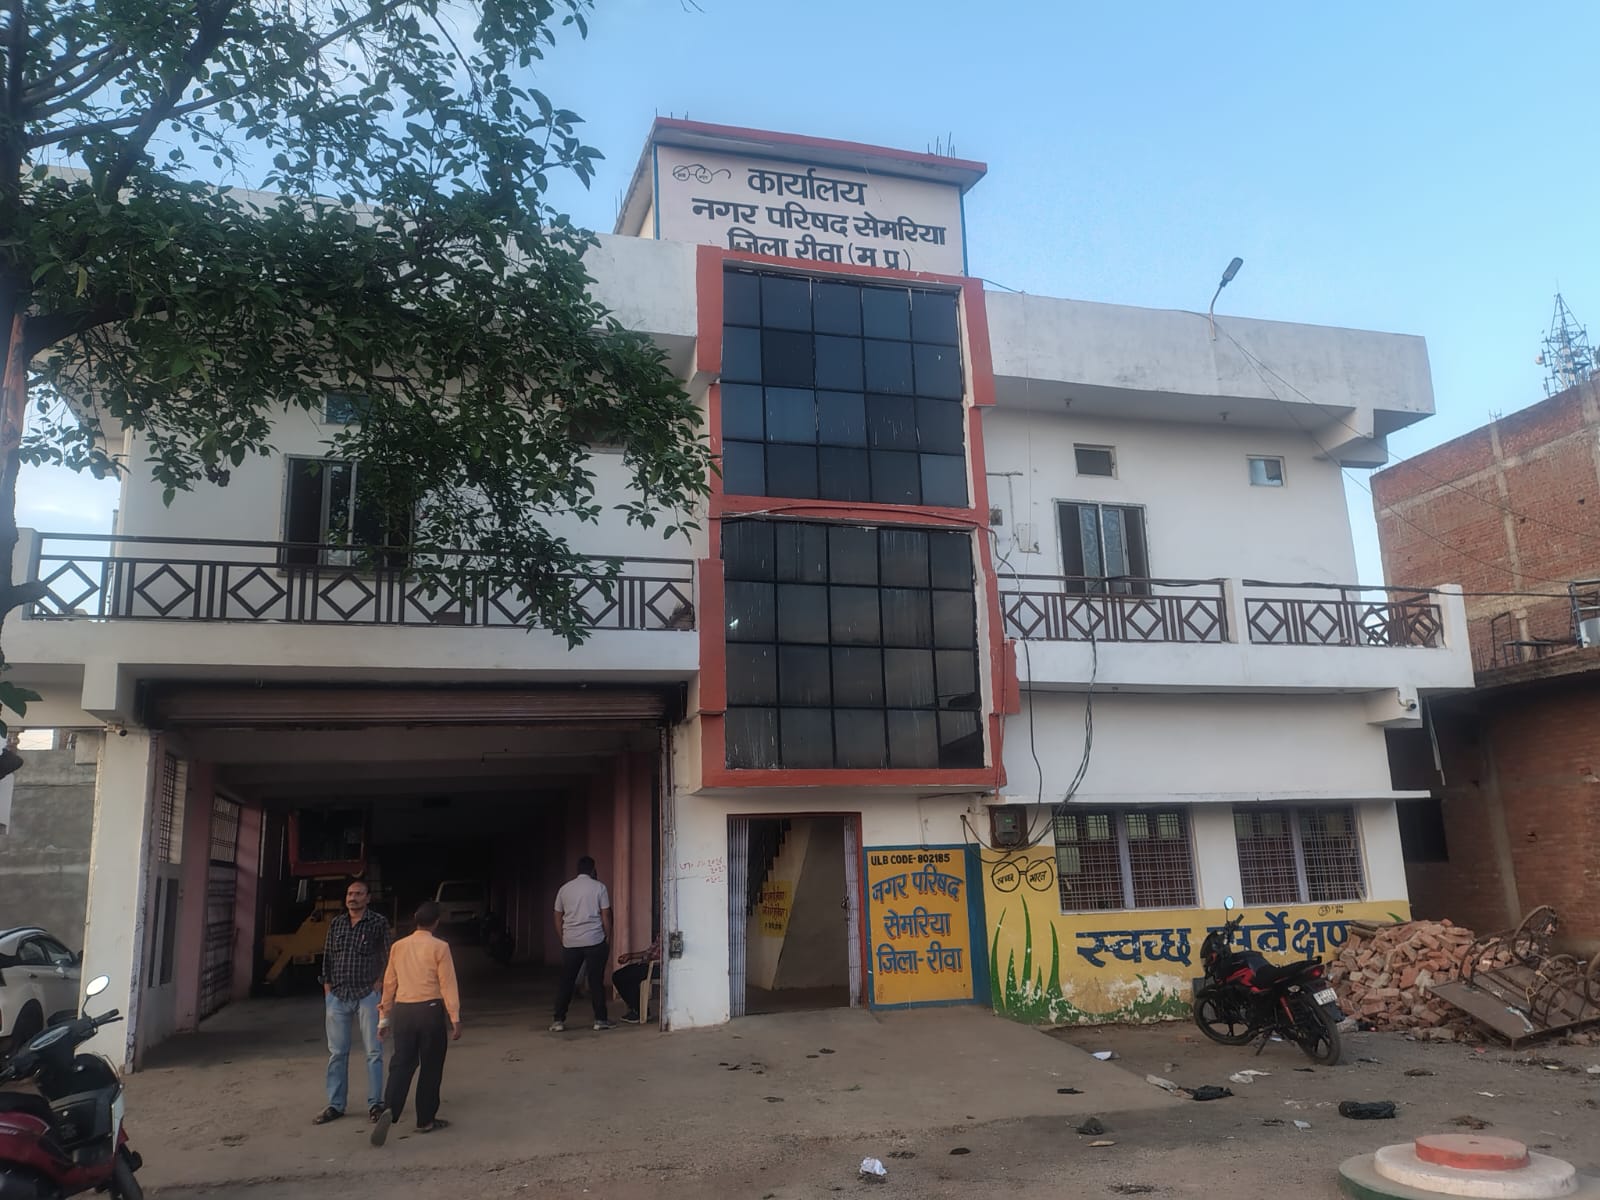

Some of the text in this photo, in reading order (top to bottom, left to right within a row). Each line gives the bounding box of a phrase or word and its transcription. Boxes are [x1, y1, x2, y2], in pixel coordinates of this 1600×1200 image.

[748, 168, 867, 205] कार्यालय
[692, 198, 947, 246] नगर परिषद सेमरिया
[727, 227, 789, 257] जिला
[795, 234, 844, 264] रीवा
[871, 855, 889, 866] ULB
[872, 863, 964, 904] नगर परिषद
[884, 906, 952, 940] सेमरिया
[1076, 927, 1191, 968] स्वच्छ
